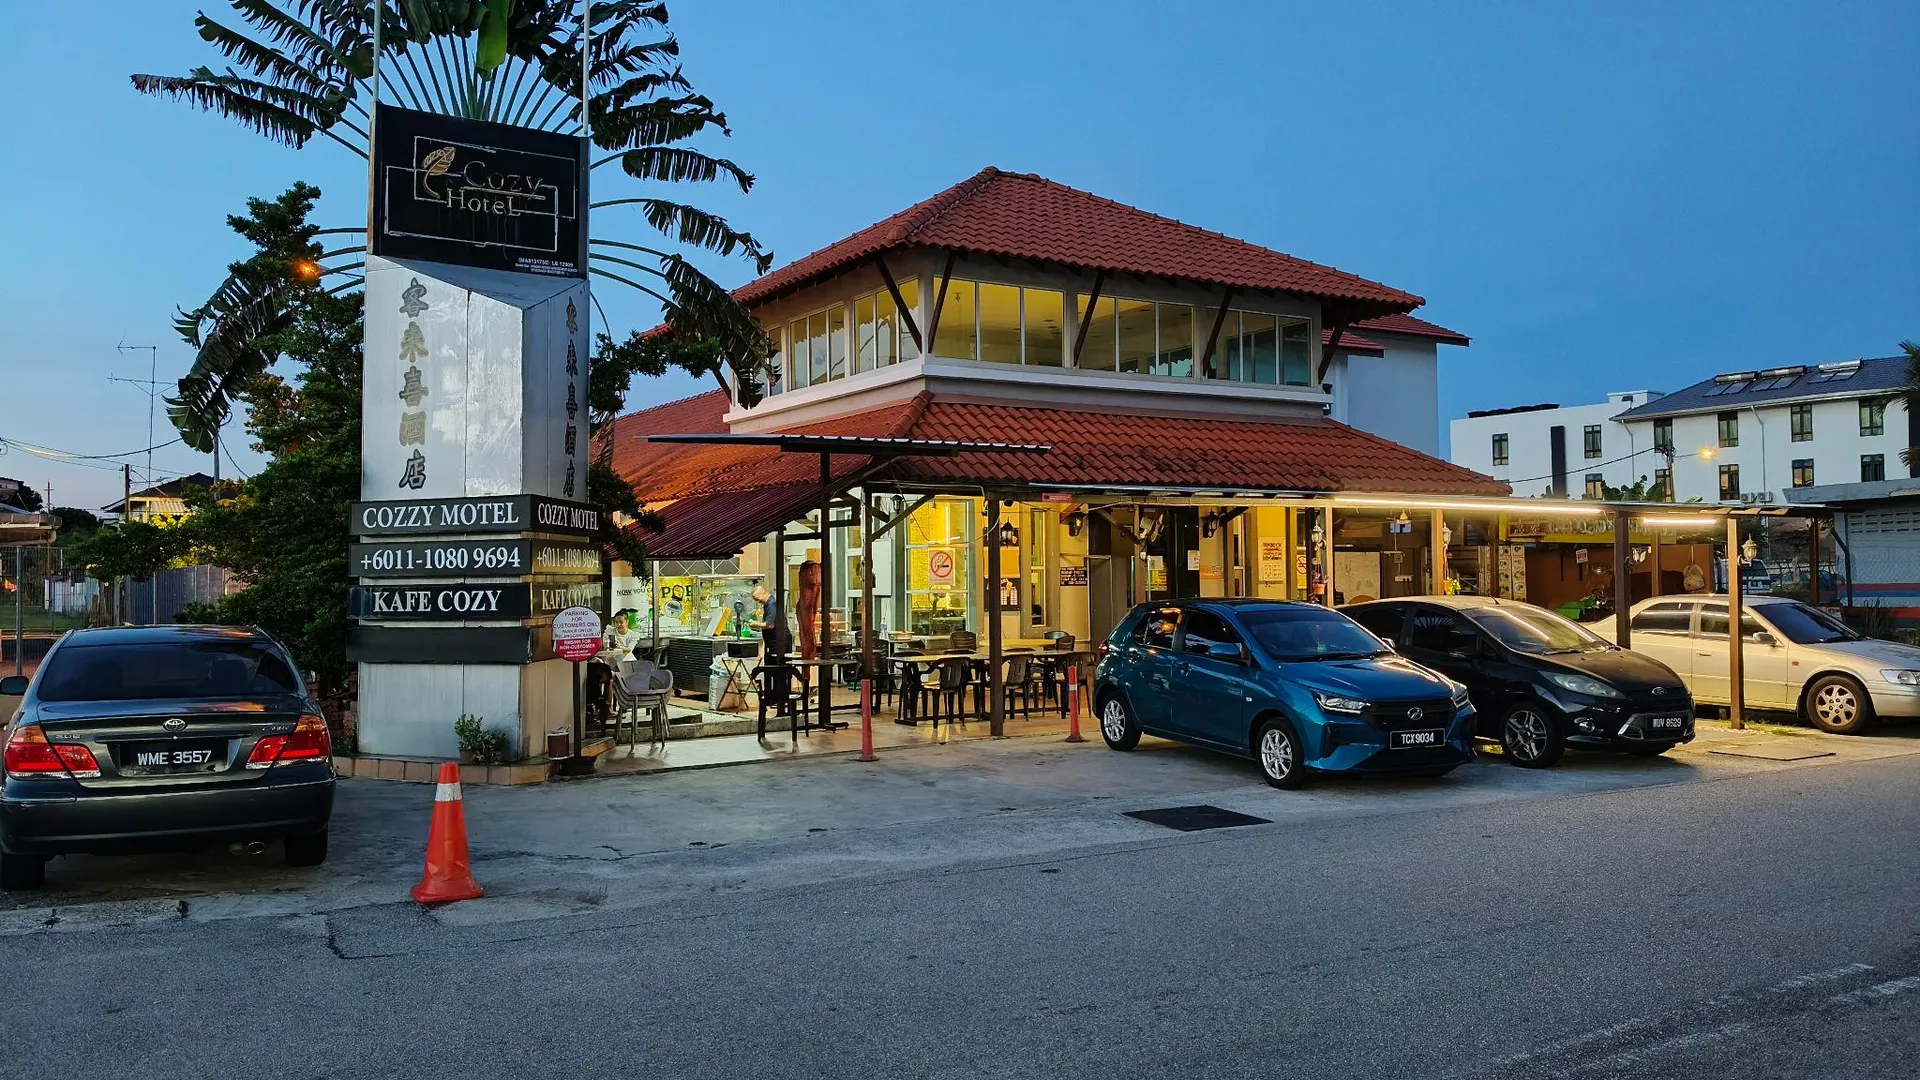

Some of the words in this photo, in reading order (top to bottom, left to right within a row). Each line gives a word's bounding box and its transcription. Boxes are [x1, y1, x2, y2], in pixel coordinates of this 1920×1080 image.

[362, 505, 436, 529] COZZY
[439, 502, 520, 526] MOTEL
[538, 502, 569, 527] COZZY
[570, 507, 600, 531] MOTEL
[360, 548, 469, 570] +6011-1080
[473, 547, 521, 569] 9694
[536, 546, 581, 568] +6011-1080
[582, 549, 600, 568] 9694
[373, 591, 432, 613] KAFE
[437, 590, 502, 612] COZY
[541, 589, 567, 610] KAFE
[137, 751, 169, 766] WME
[172, 749, 212, 764] 3557
